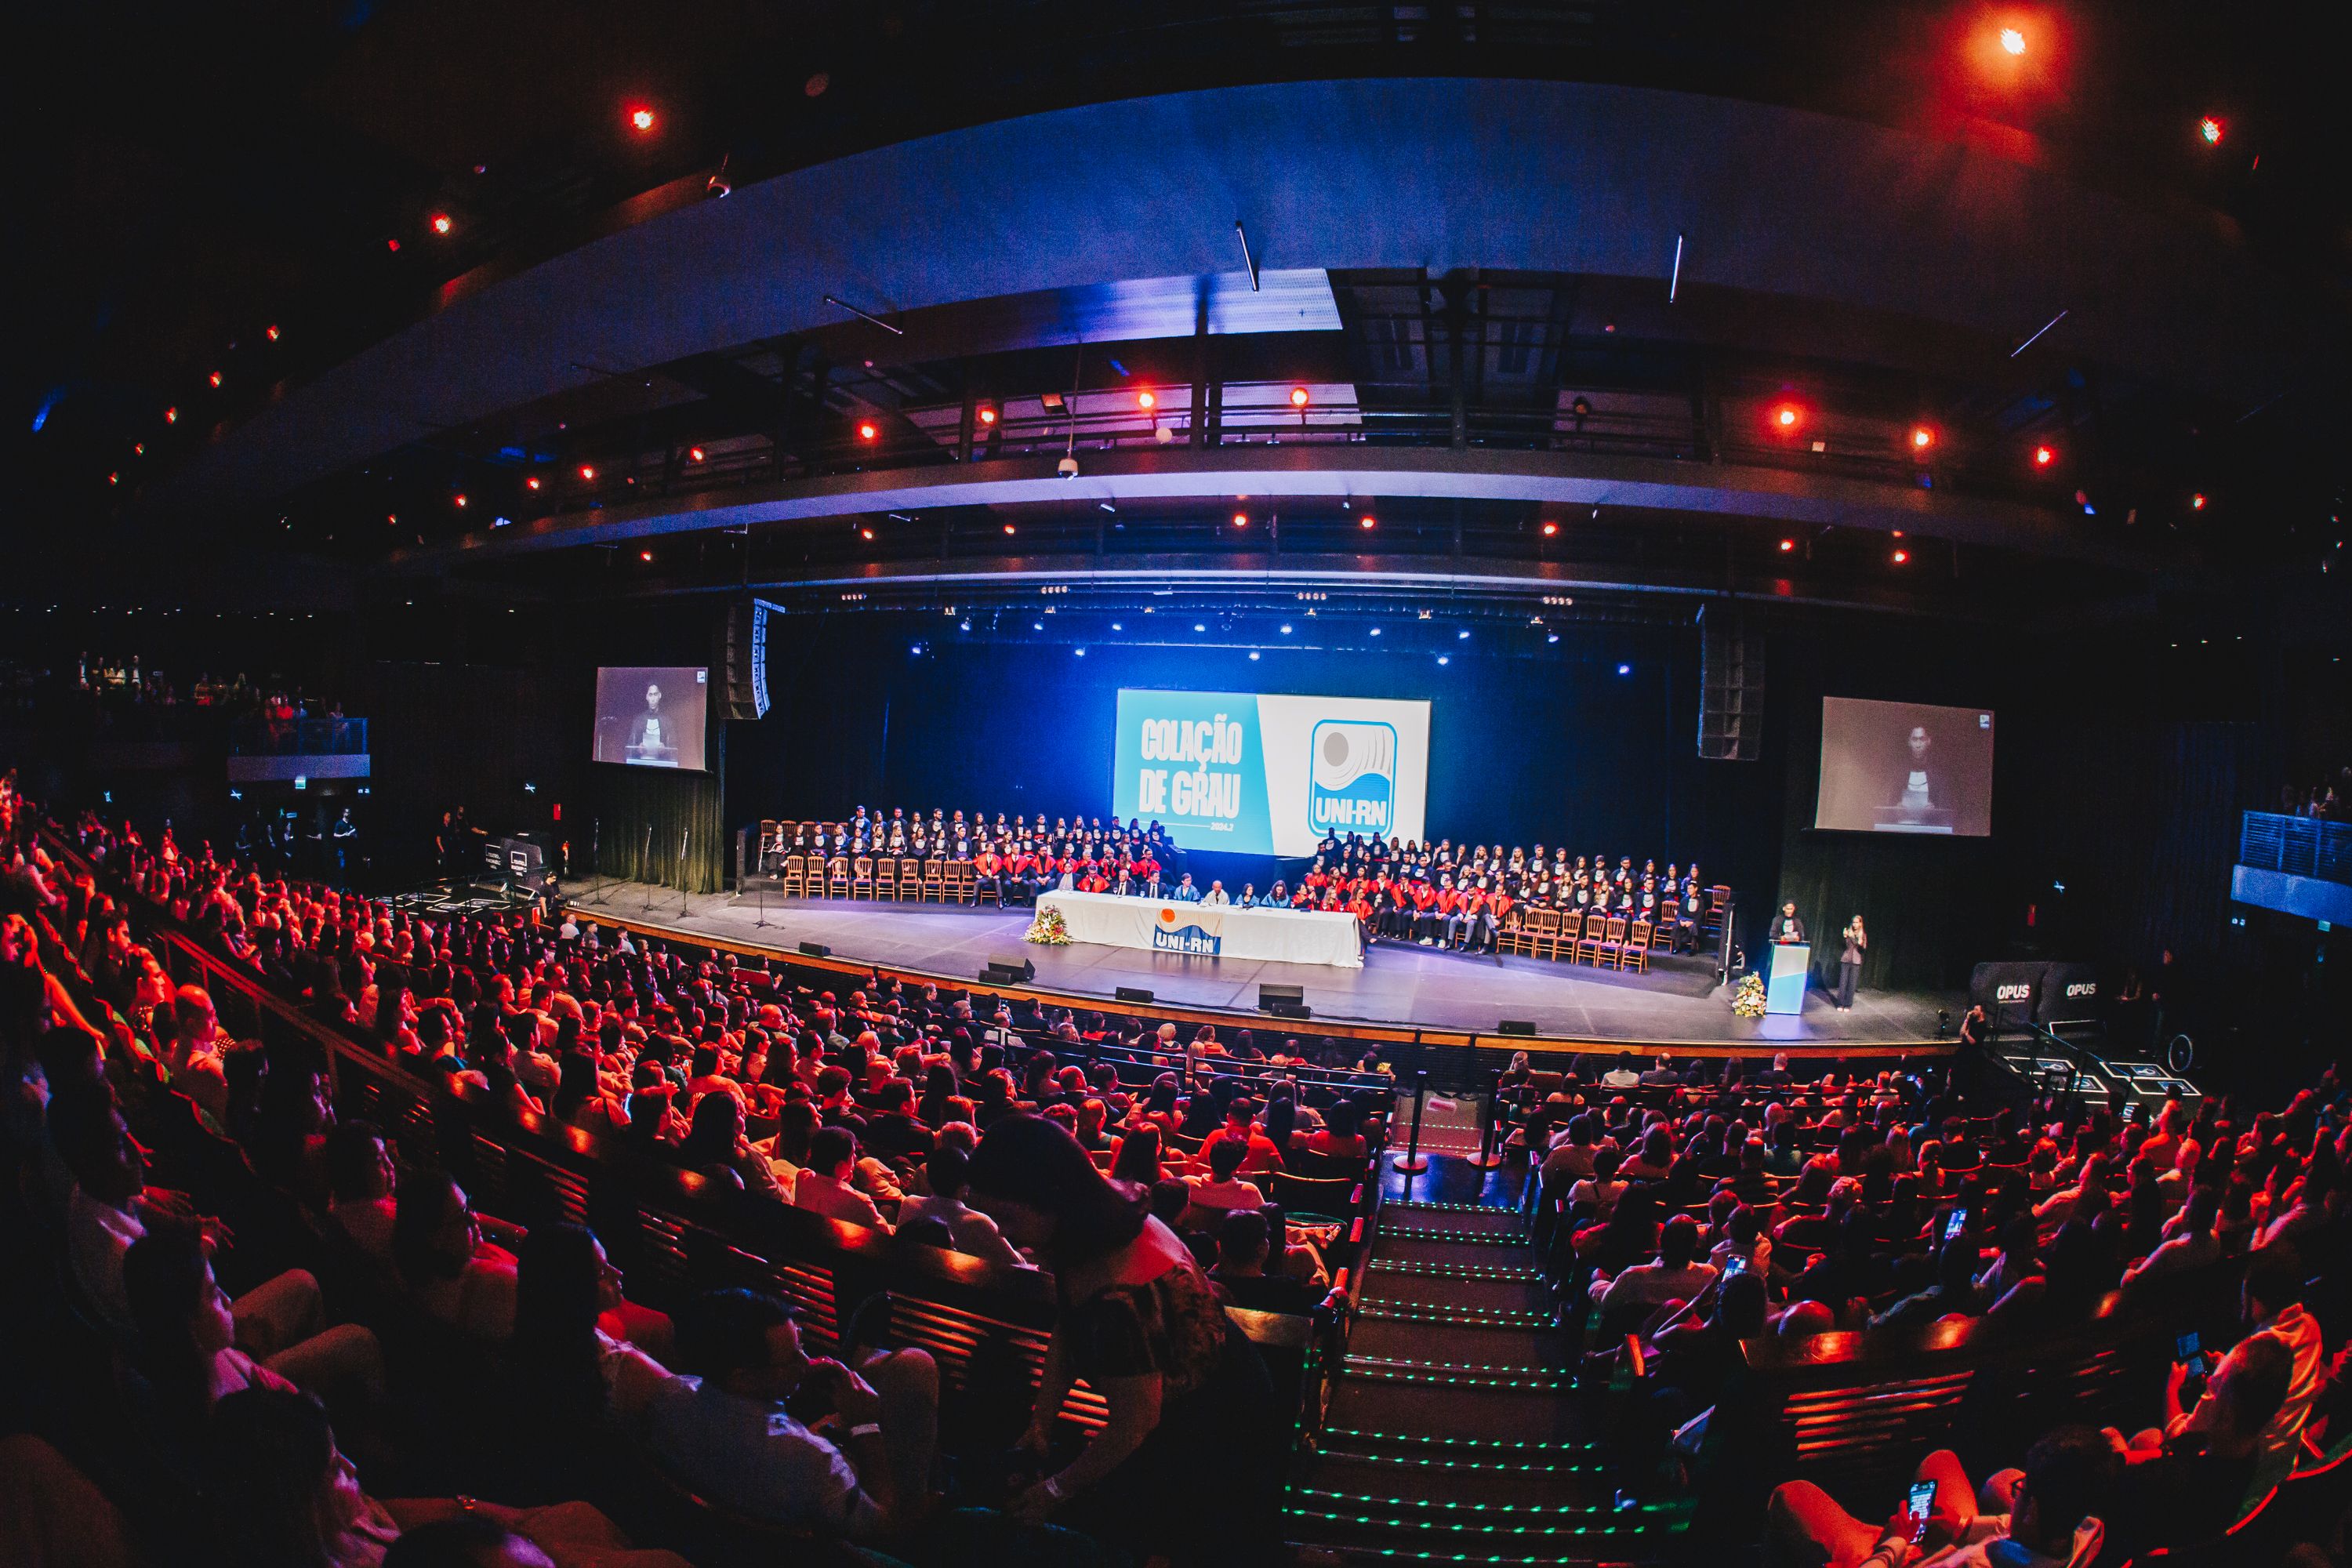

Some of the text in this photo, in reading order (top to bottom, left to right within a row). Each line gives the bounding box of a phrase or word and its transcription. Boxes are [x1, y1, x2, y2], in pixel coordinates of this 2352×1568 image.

[1142, 713, 1243, 773] COLAÇÃO
[1139, 769, 1241, 818] DE GRAU
[1316, 797, 1387, 826] UNI-RN
[1156, 932, 1214, 953] UNI-RN
[1997, 985, 2030, 1000] OPUS
[2067, 983, 2096, 996] OPUS
